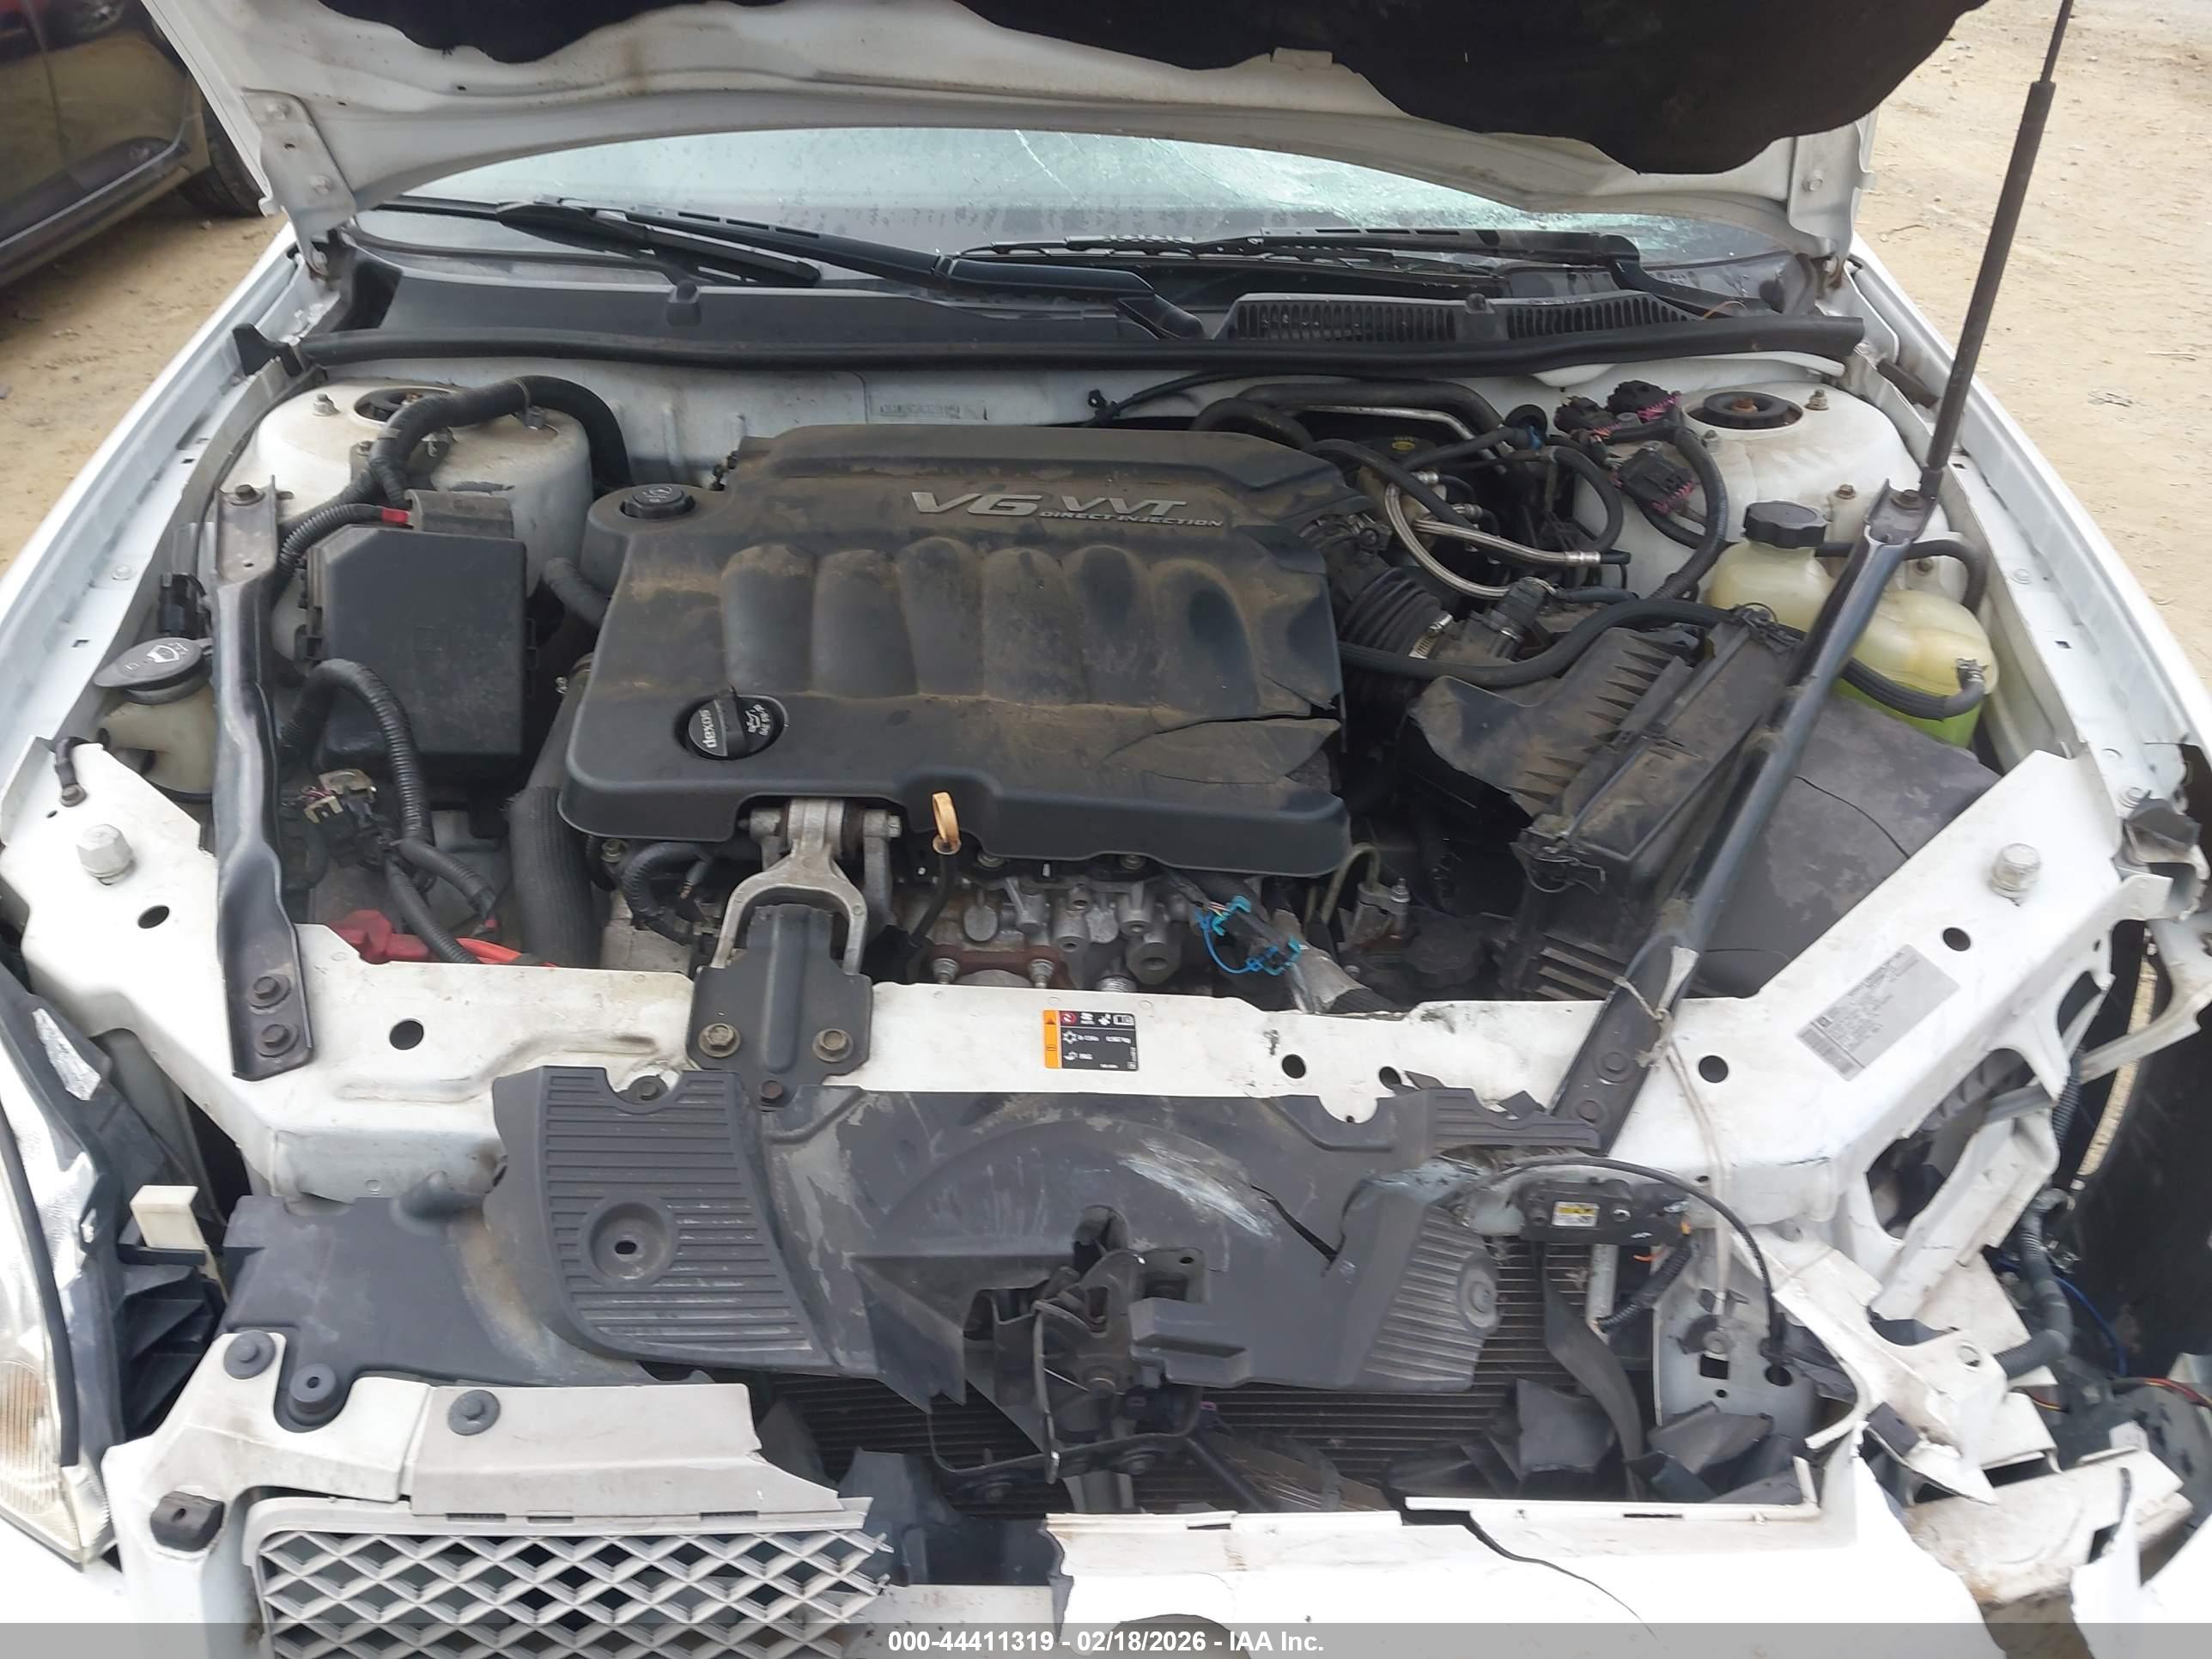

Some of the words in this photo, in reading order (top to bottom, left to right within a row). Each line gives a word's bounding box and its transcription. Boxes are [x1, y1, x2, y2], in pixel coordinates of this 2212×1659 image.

[911, 492, 1042, 516] V6
[1061, 495, 1187, 516] VVT
[1039, 511, 1115, 520] DIRECT
[1117, 514, 1224, 526] INJECTION
[699, 709, 718, 748] dexos
